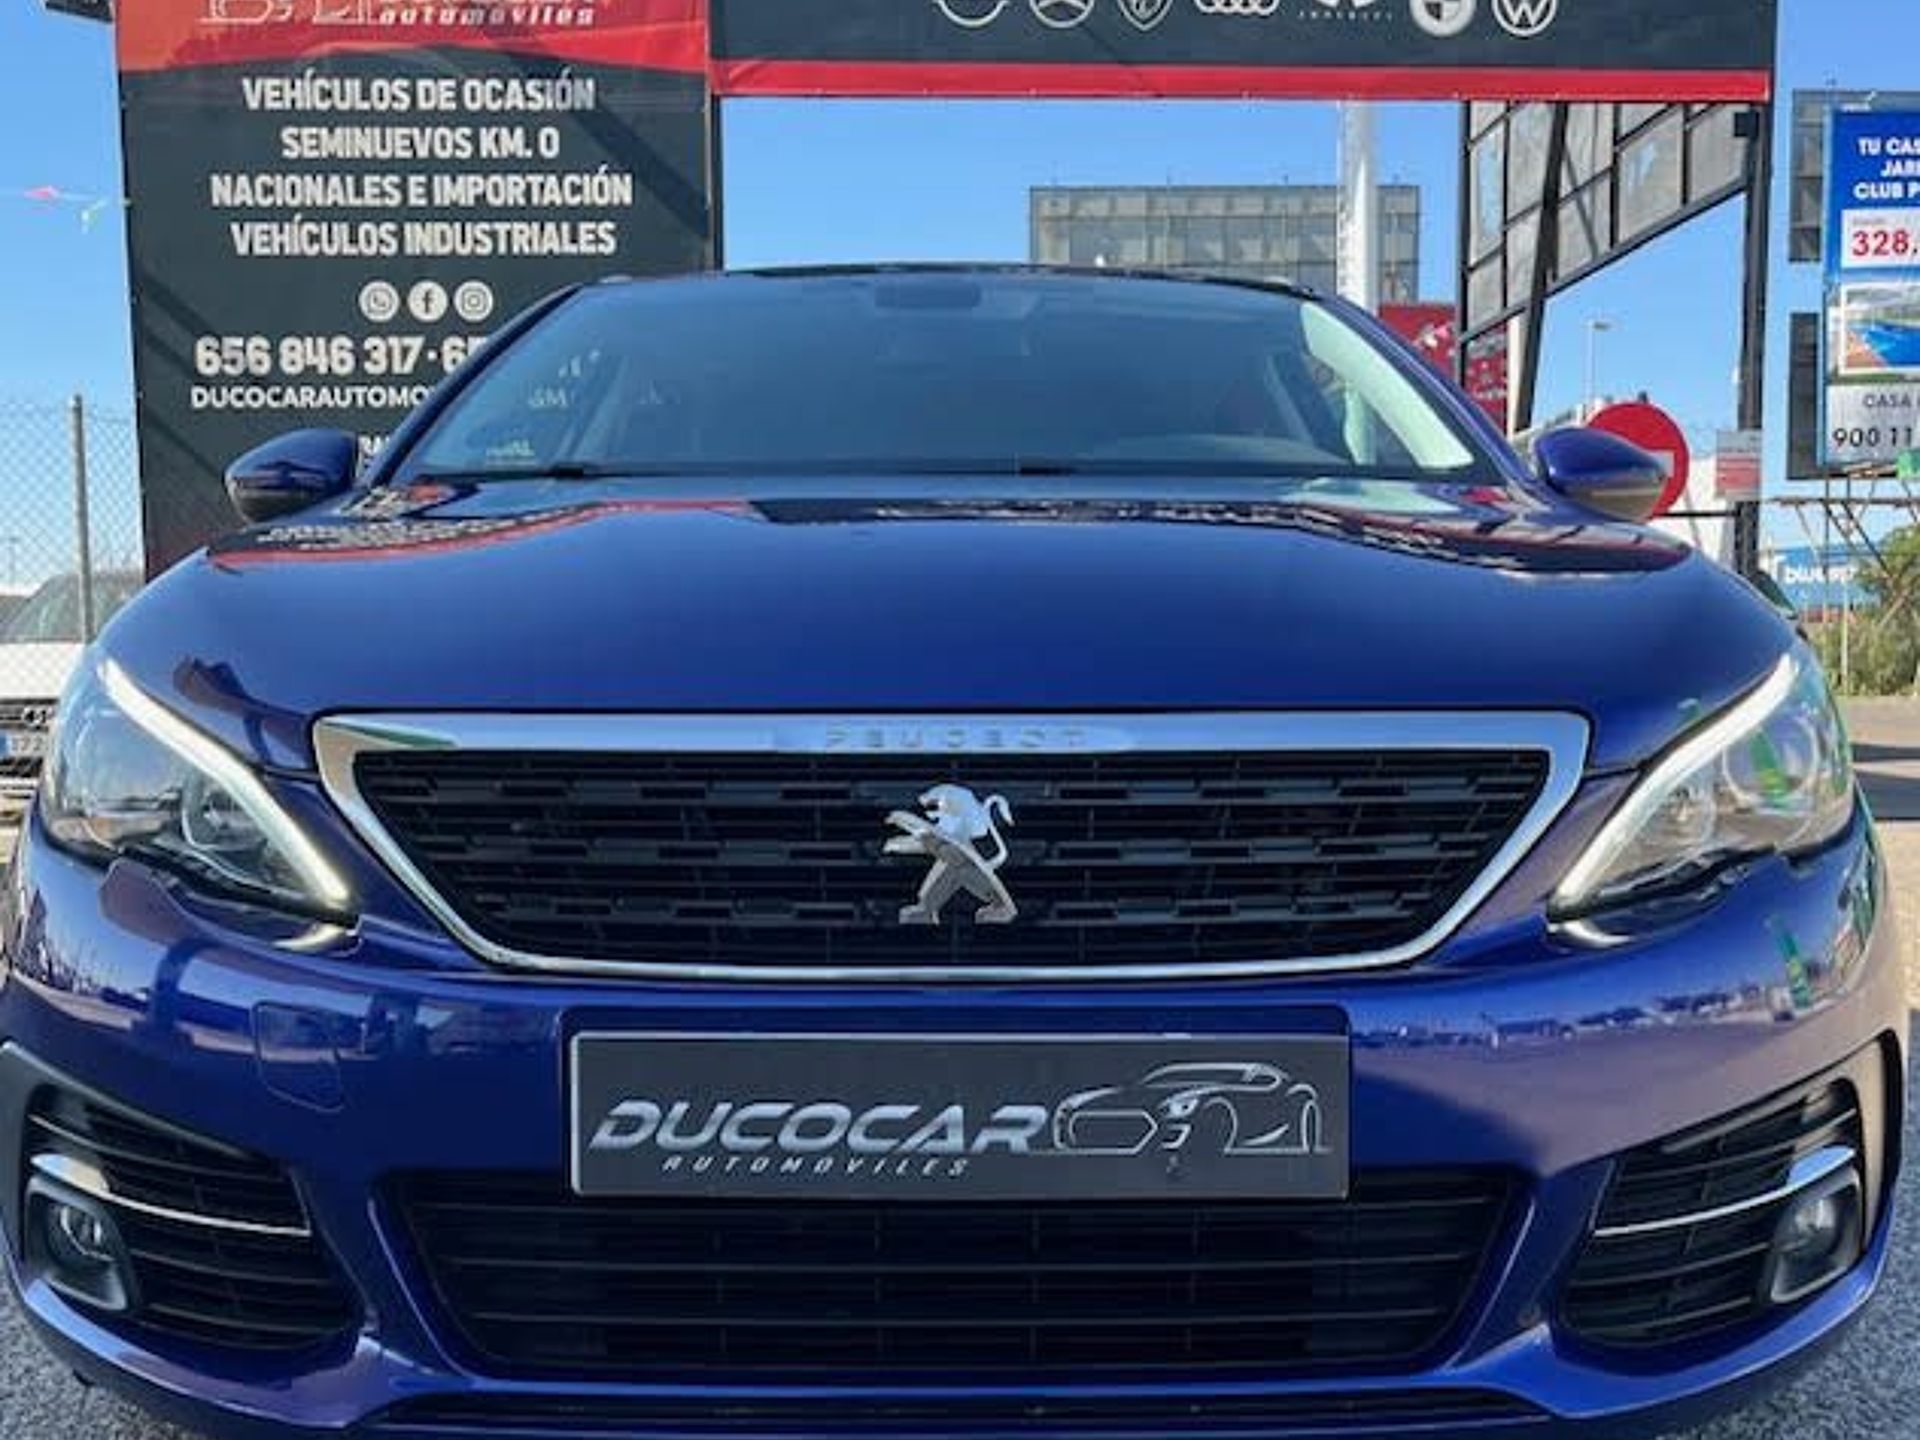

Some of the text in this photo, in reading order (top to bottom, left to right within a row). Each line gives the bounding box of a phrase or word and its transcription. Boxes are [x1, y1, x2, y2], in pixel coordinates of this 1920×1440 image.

[242, 68, 595, 112] VEHÍCULOS DE OCASIÓN
[280, 126, 473, 160] SEMINUEVOS
[479, 126, 533, 159] KM.
[1858, 136, 1881, 156] TU
[210, 164, 633, 207] NACIONALES E IMPORTACIÓN
[1853, 181, 1904, 200] CLUB
[231, 213, 617, 257] VEHÍCULOS INDUSTRIALES
[195, 335, 272, 376] 656
[279, 335, 356, 376] 846
[190, 384, 437, 409] DUCOCARAUTOMO
[1862, 392, 1912, 408] CASA
[1833, 427, 1881, 448] 900
[590, 1099, 1047, 1153] DUCOCAR
[662, 1155, 969, 1177] AUTOMOVILES
